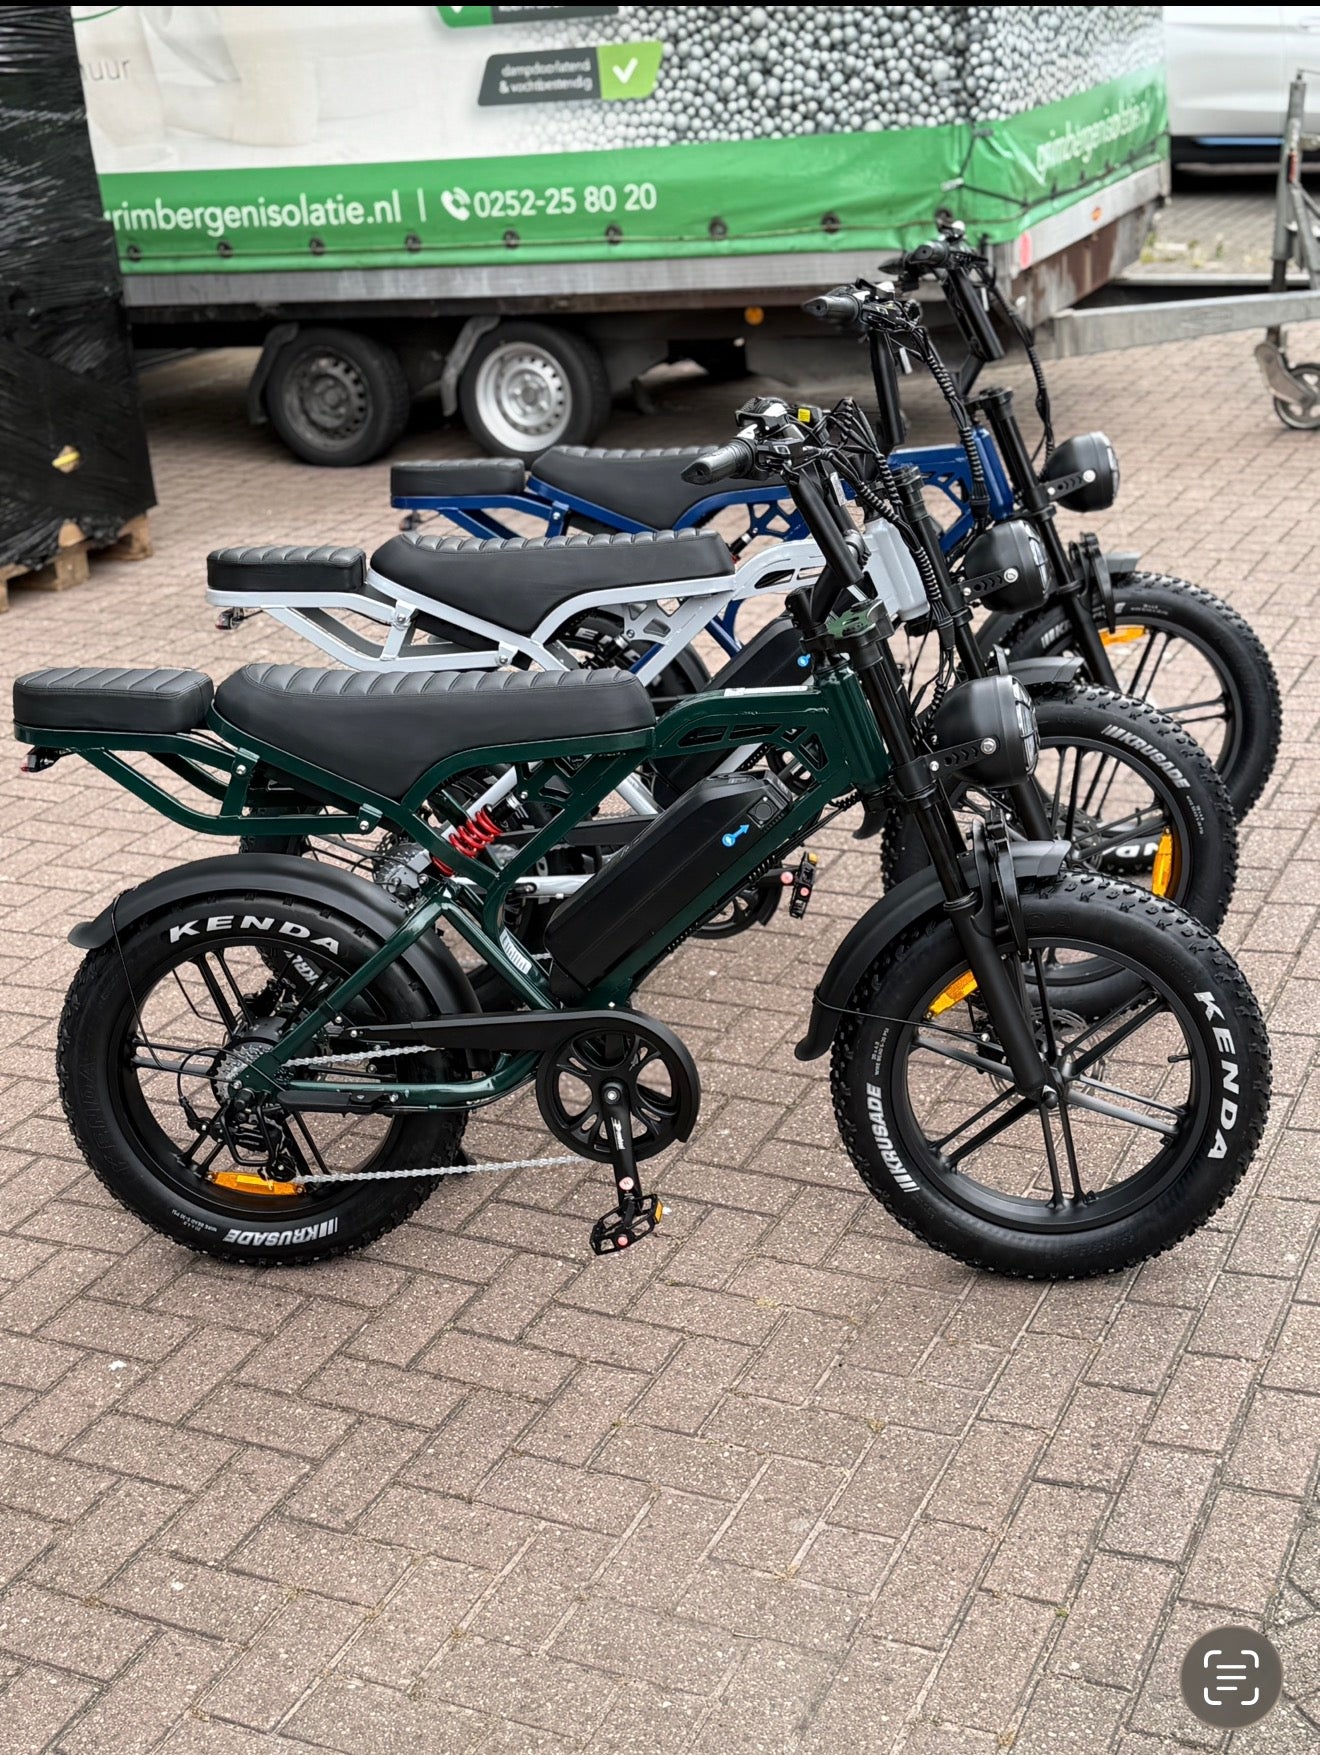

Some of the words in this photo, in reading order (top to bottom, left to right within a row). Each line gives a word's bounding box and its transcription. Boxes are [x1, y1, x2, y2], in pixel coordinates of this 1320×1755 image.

[80, 59, 130, 81] uur
[474, 186, 577, 218] 0252-25
[583, 185, 617, 213] 80
[623, 182, 657, 211] 20
[1122, 732, 1191, 788] KRUSADE
[169, 915, 340, 955] KENDA
[1193, 991, 1240, 1159] KENDA
[866, 1082, 909, 1175] KRUSADE
[222, 1224, 319, 1247] KRUSADE
